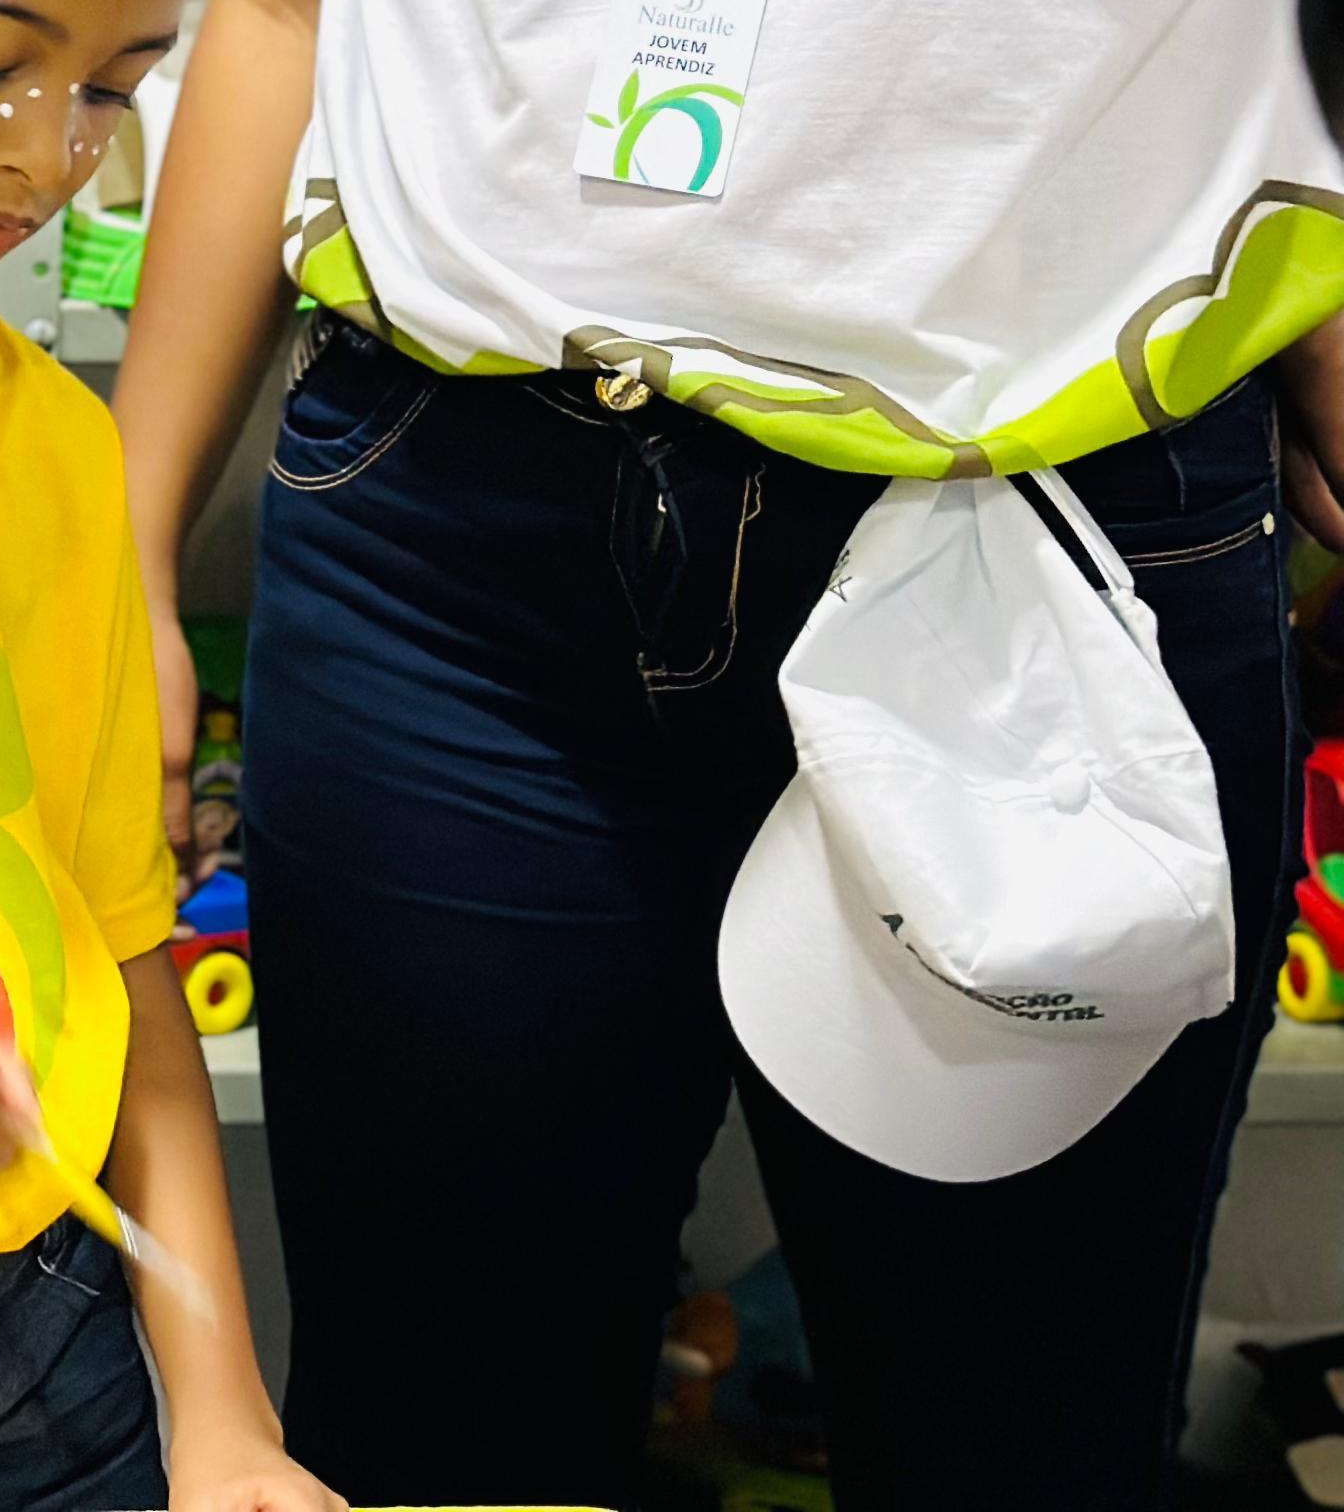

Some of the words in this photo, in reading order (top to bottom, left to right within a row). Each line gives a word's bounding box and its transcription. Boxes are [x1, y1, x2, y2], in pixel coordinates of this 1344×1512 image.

[637, 5, 736, 38] Naturalle
[649, 34, 708, 55] JOVEM
[631, 51, 717, 76] APRENDIZ
